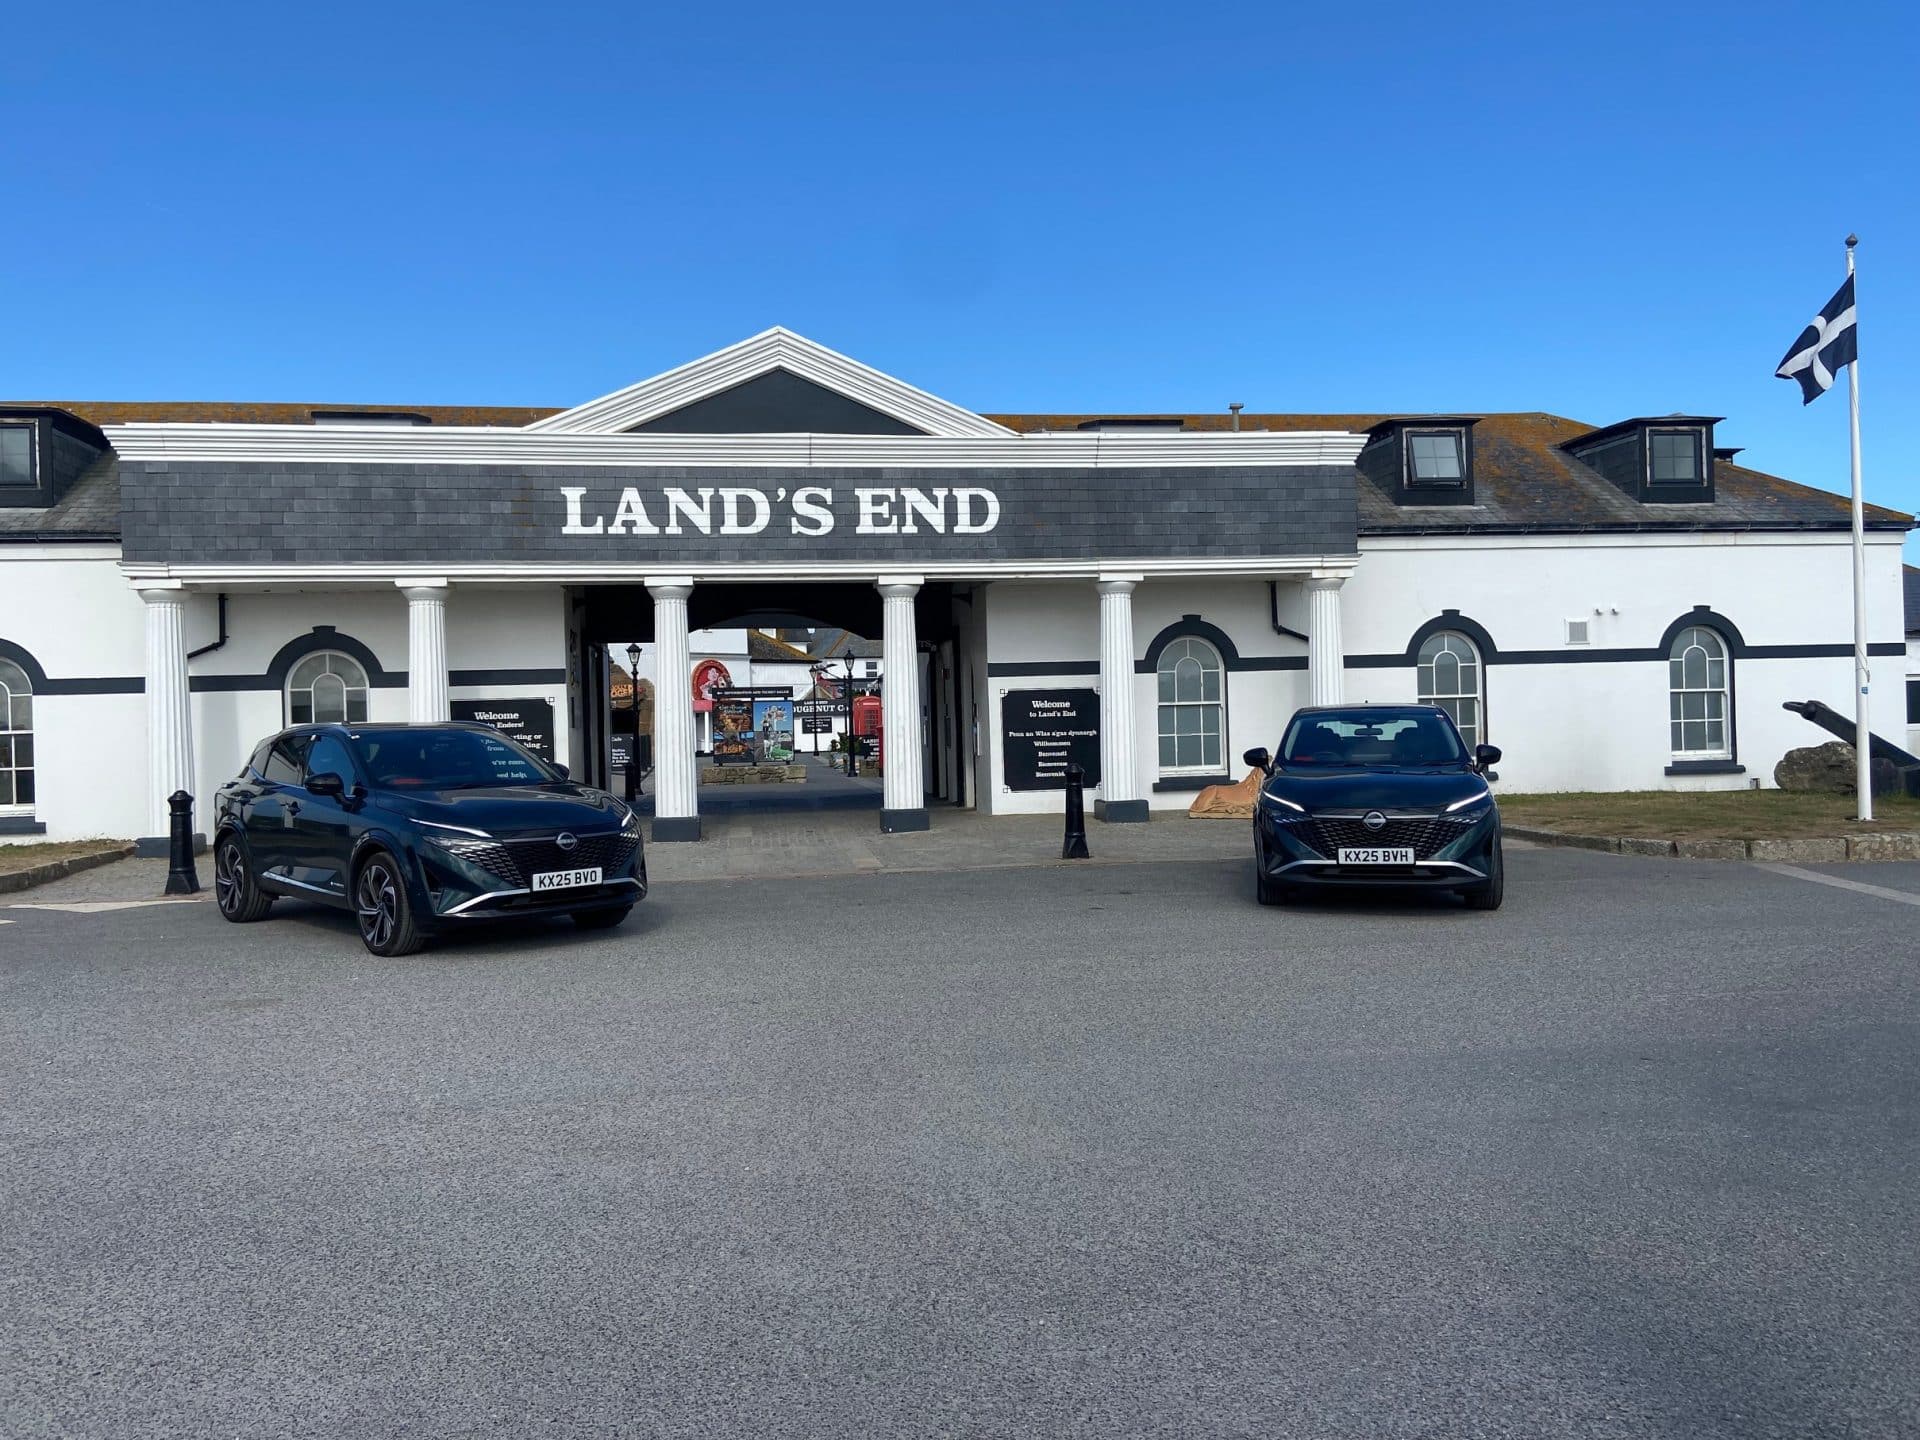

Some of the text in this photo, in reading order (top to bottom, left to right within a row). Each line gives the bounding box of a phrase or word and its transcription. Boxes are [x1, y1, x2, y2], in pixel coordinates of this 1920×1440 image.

[560, 486, 1000, 536] LAND'S END
[1032, 700, 1071, 709] Welcome
[474, 711, 520, 721] Welcome
[497, 721, 525, 729] Enders!
[1344, 850, 1408, 862] KX25 BVH
[539, 870, 597, 888] KX25 BVO
